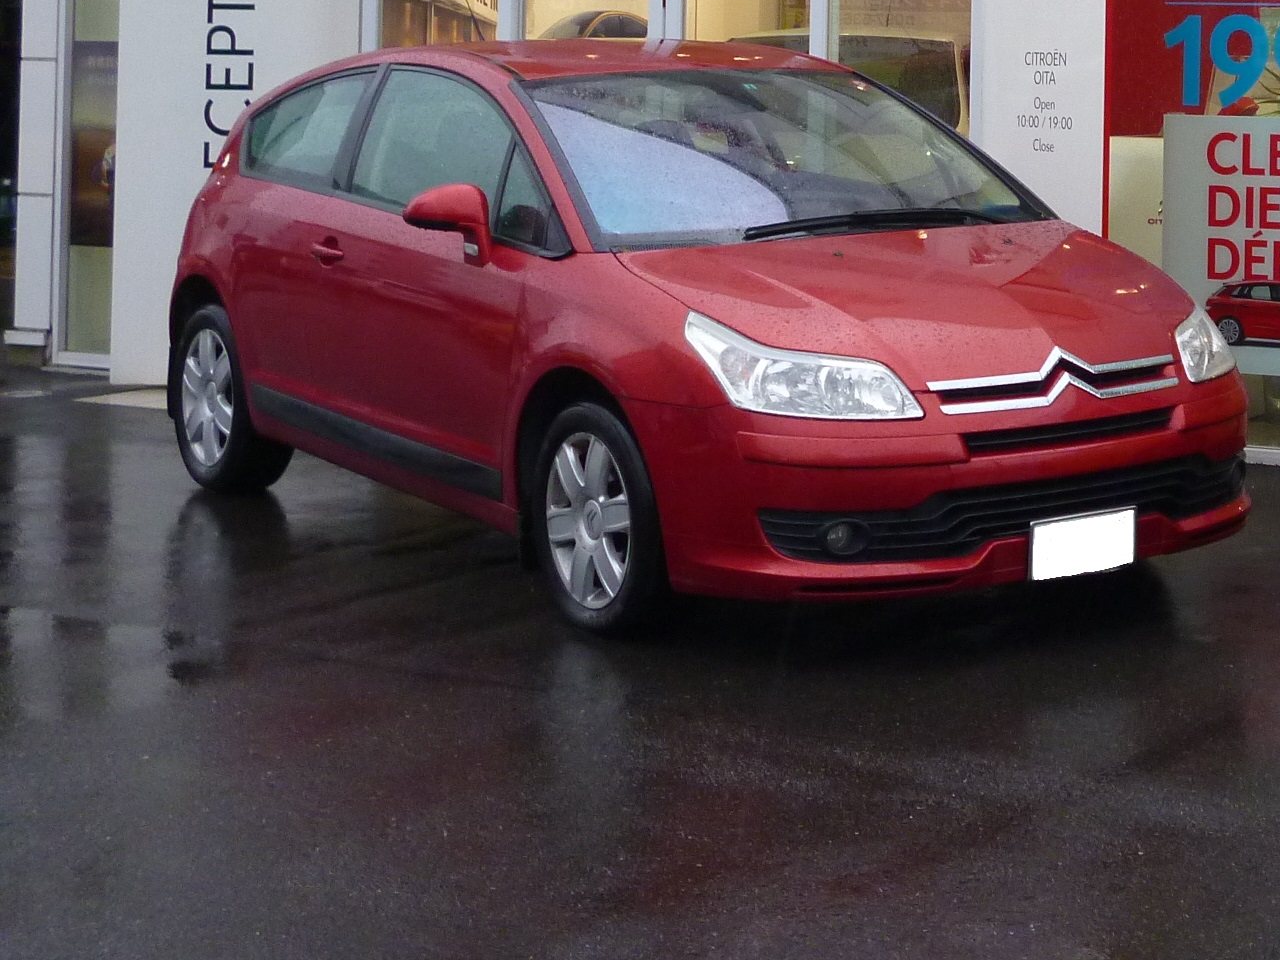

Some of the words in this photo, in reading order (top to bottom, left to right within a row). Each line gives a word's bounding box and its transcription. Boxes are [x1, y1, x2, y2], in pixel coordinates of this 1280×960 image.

[1033, 70, 1056, 85] OITA
[1033, 96, 1056, 114] Open
[1032, 138, 1055, 153] Close
